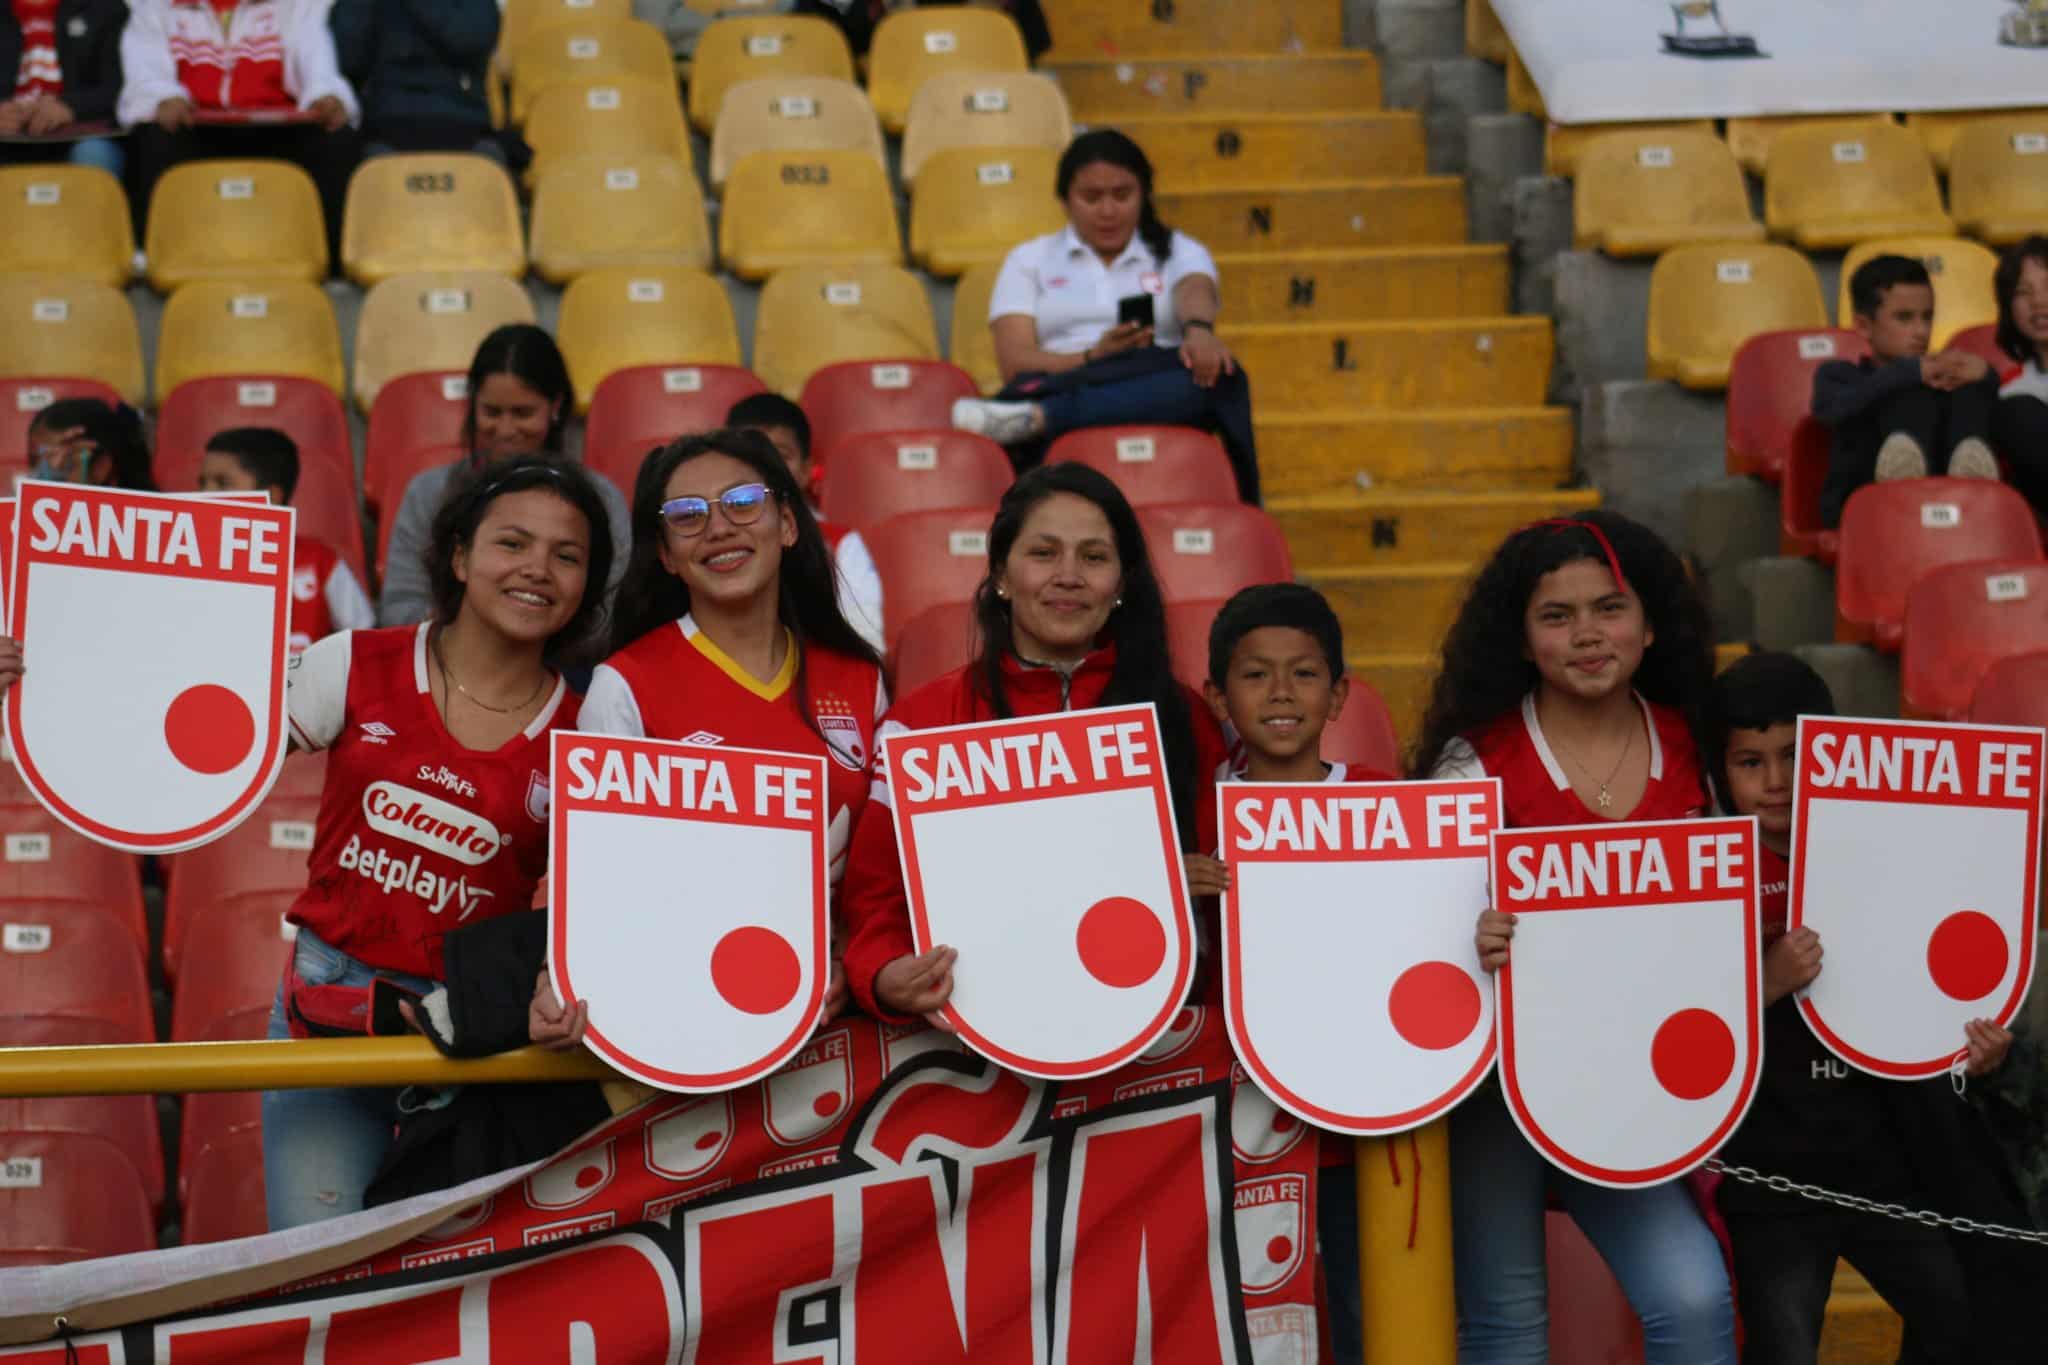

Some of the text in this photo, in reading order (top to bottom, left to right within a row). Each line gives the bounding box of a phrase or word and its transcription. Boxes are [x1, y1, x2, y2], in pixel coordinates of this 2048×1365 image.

[30, 497, 280, 575] SANTA FE
[566, 746, 813, 821] SANTA FE
[901, 721, 1152, 803] SANTA FE
[1809, 732, 2033, 798] SANTA FE
[367, 788, 497, 857] Colanta
[1234, 793, 1489, 852] SANTA FE
[338, 833, 458, 915] Betplay
[1506, 832, 1745, 901] SANTA FE
[6, 1163, 33, 1179] 029
[1234, 1181, 1301, 1208] ANTA FE
